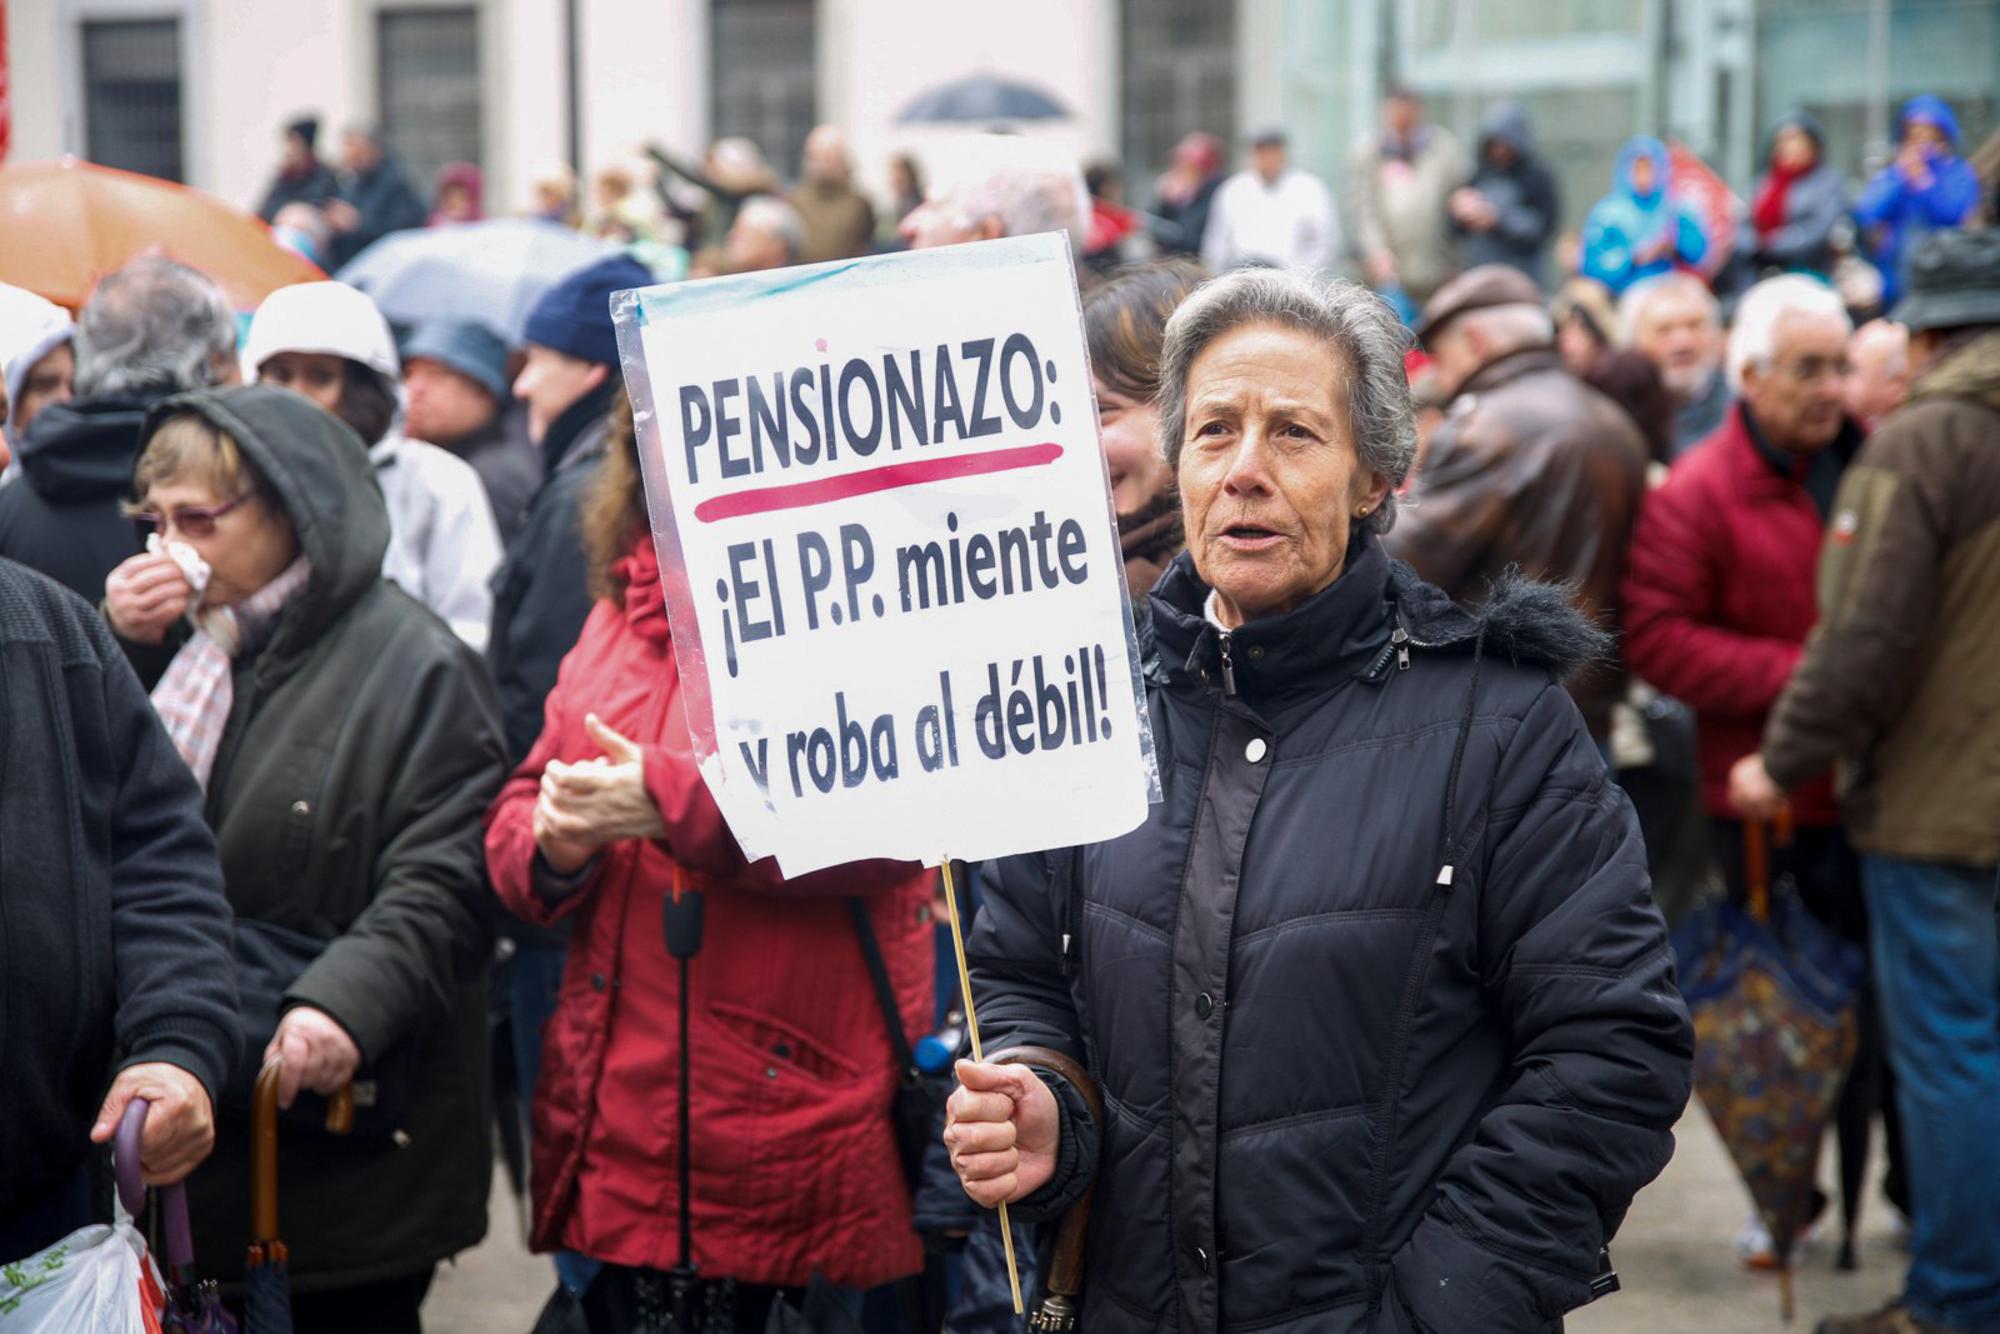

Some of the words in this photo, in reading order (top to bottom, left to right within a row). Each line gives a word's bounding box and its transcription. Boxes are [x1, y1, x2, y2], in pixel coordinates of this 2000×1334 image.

[679, 333, 1061, 484] PENSIONAZO:
[717, 539, 786, 678] ¡El
[798, 524, 885, 630] P.P.
[897, 512, 1088, 612] miente
[787, 692, 898, 798] roba
[915, 671, 960, 773] al
[975, 644, 1112, 759] débil!
